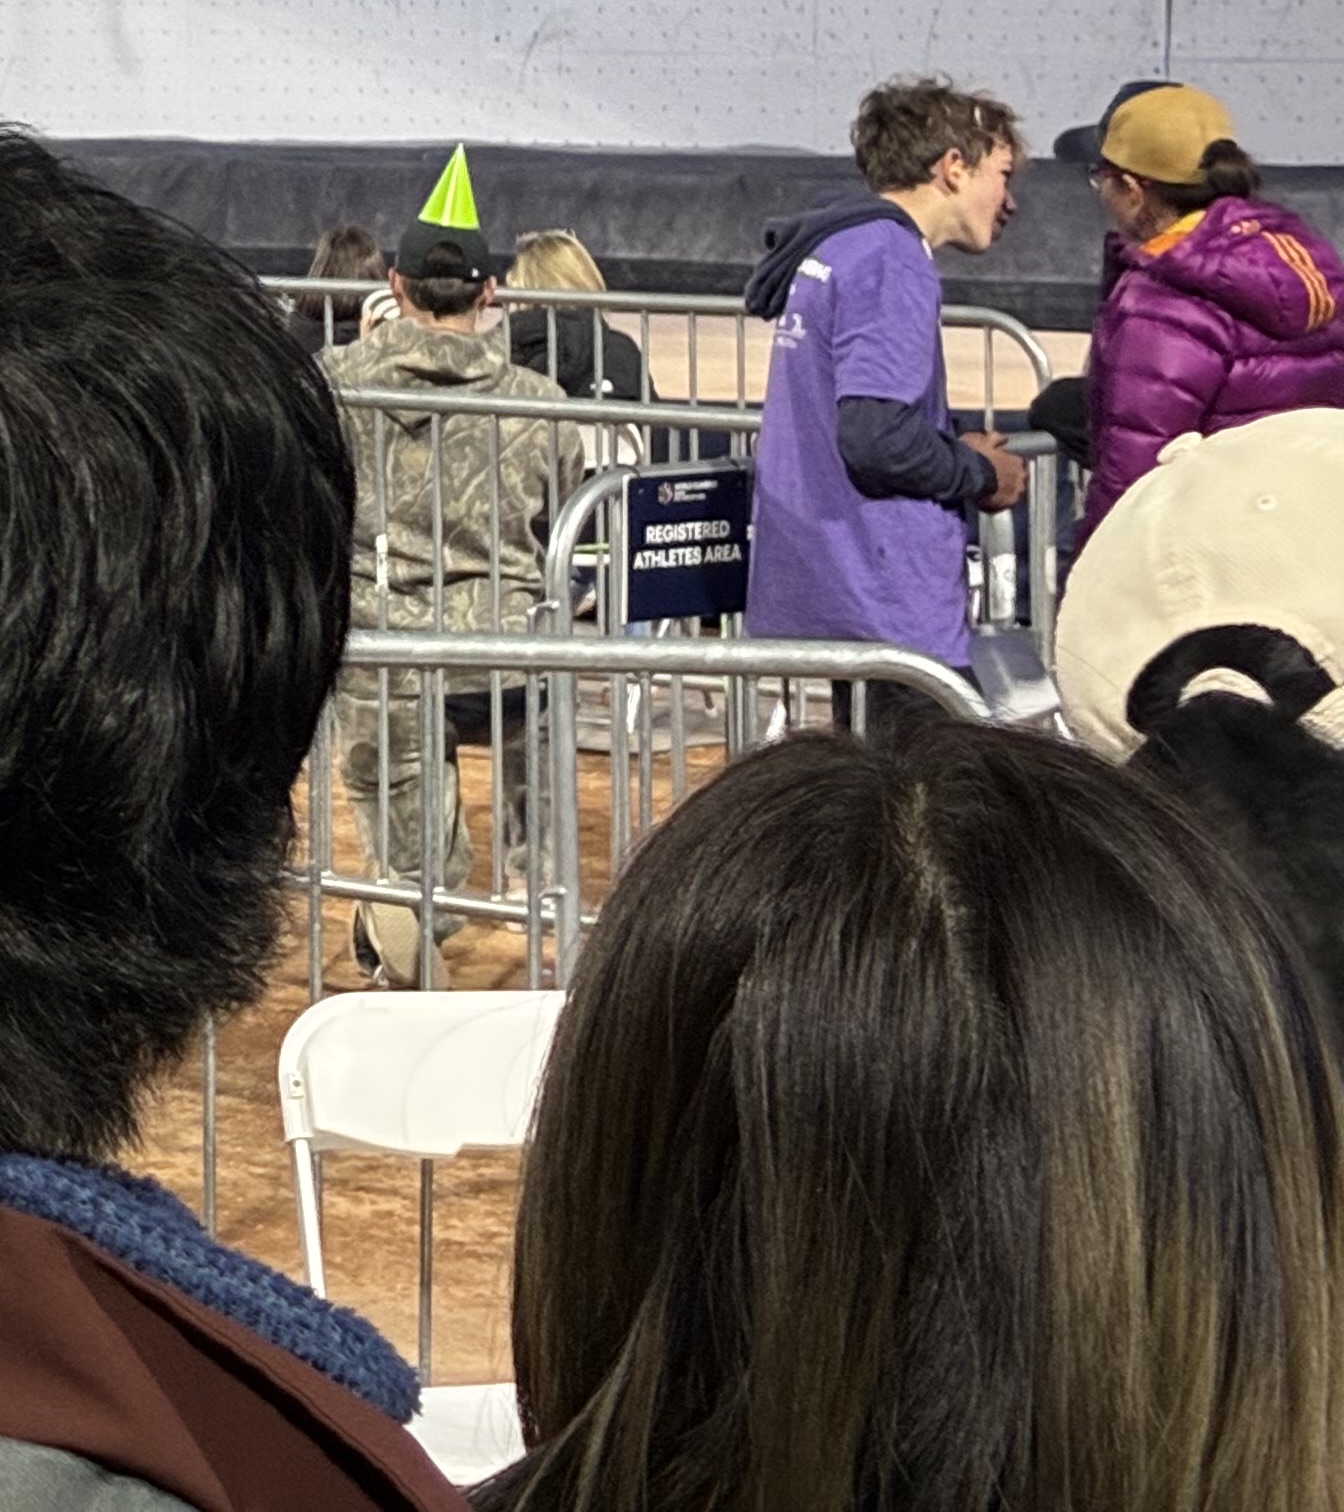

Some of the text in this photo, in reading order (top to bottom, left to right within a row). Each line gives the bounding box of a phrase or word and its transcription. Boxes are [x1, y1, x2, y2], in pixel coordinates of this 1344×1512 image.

[645, 520, 731, 544] REGISTERED
[633, 543, 743, 570] ATHLETES AREA
